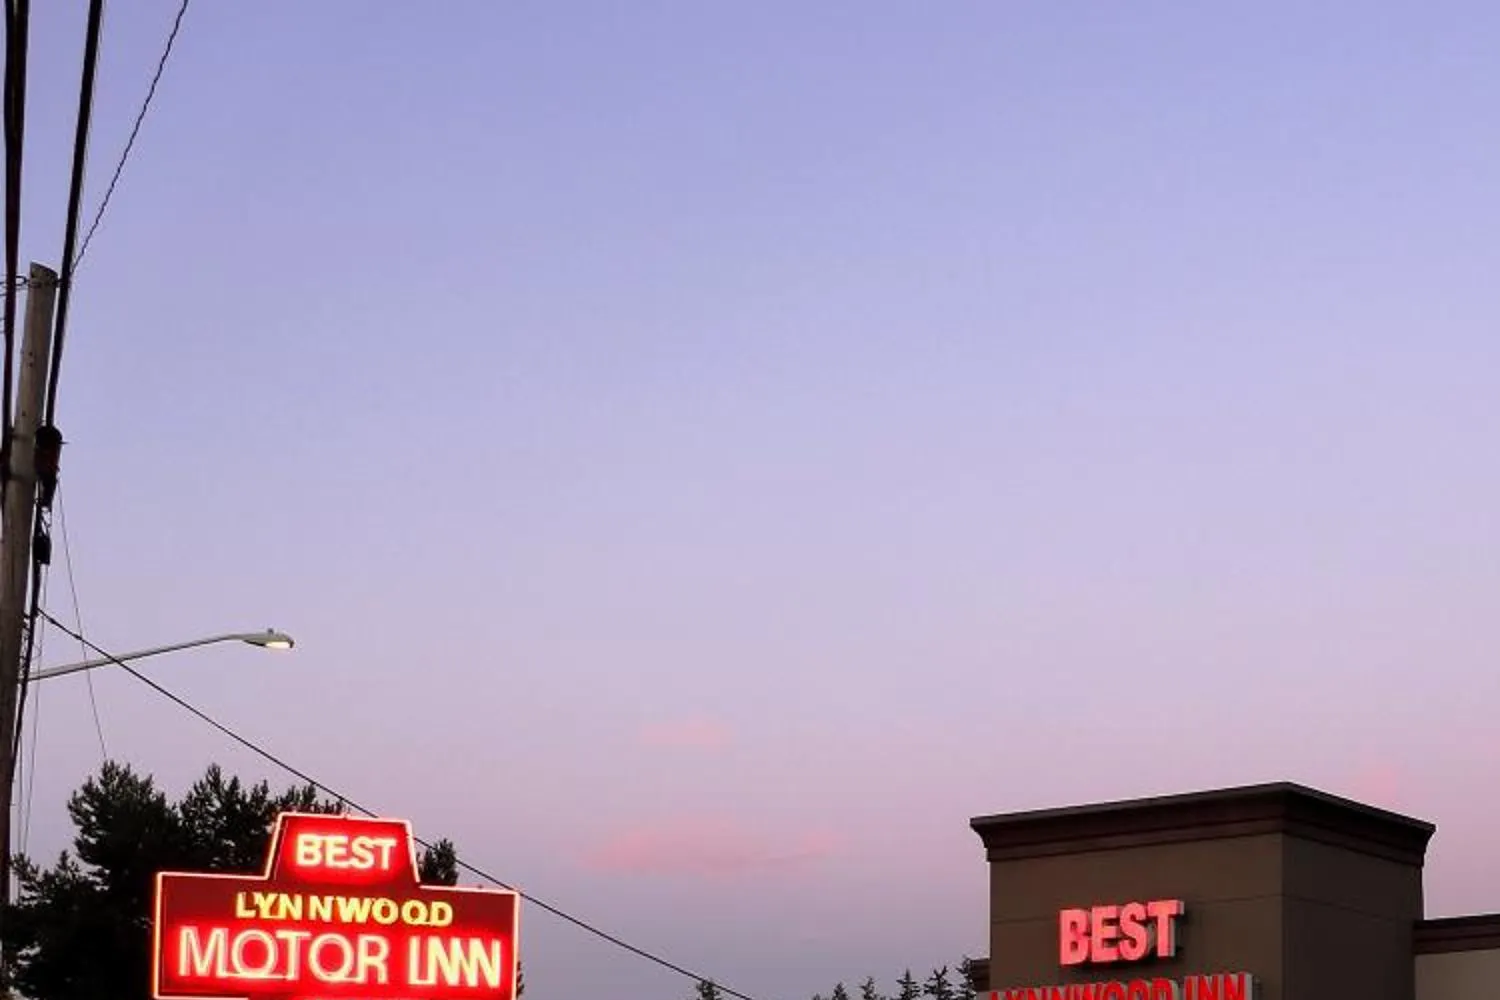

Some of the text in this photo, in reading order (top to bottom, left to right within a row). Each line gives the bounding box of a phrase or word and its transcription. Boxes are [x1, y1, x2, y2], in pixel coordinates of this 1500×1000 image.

[297, 834, 397, 871] BEST
[236, 892, 454, 927] LYNNWOOD
[1058, 900, 1184, 966] BEST
[178, 926, 502, 988] MOTOR INN
